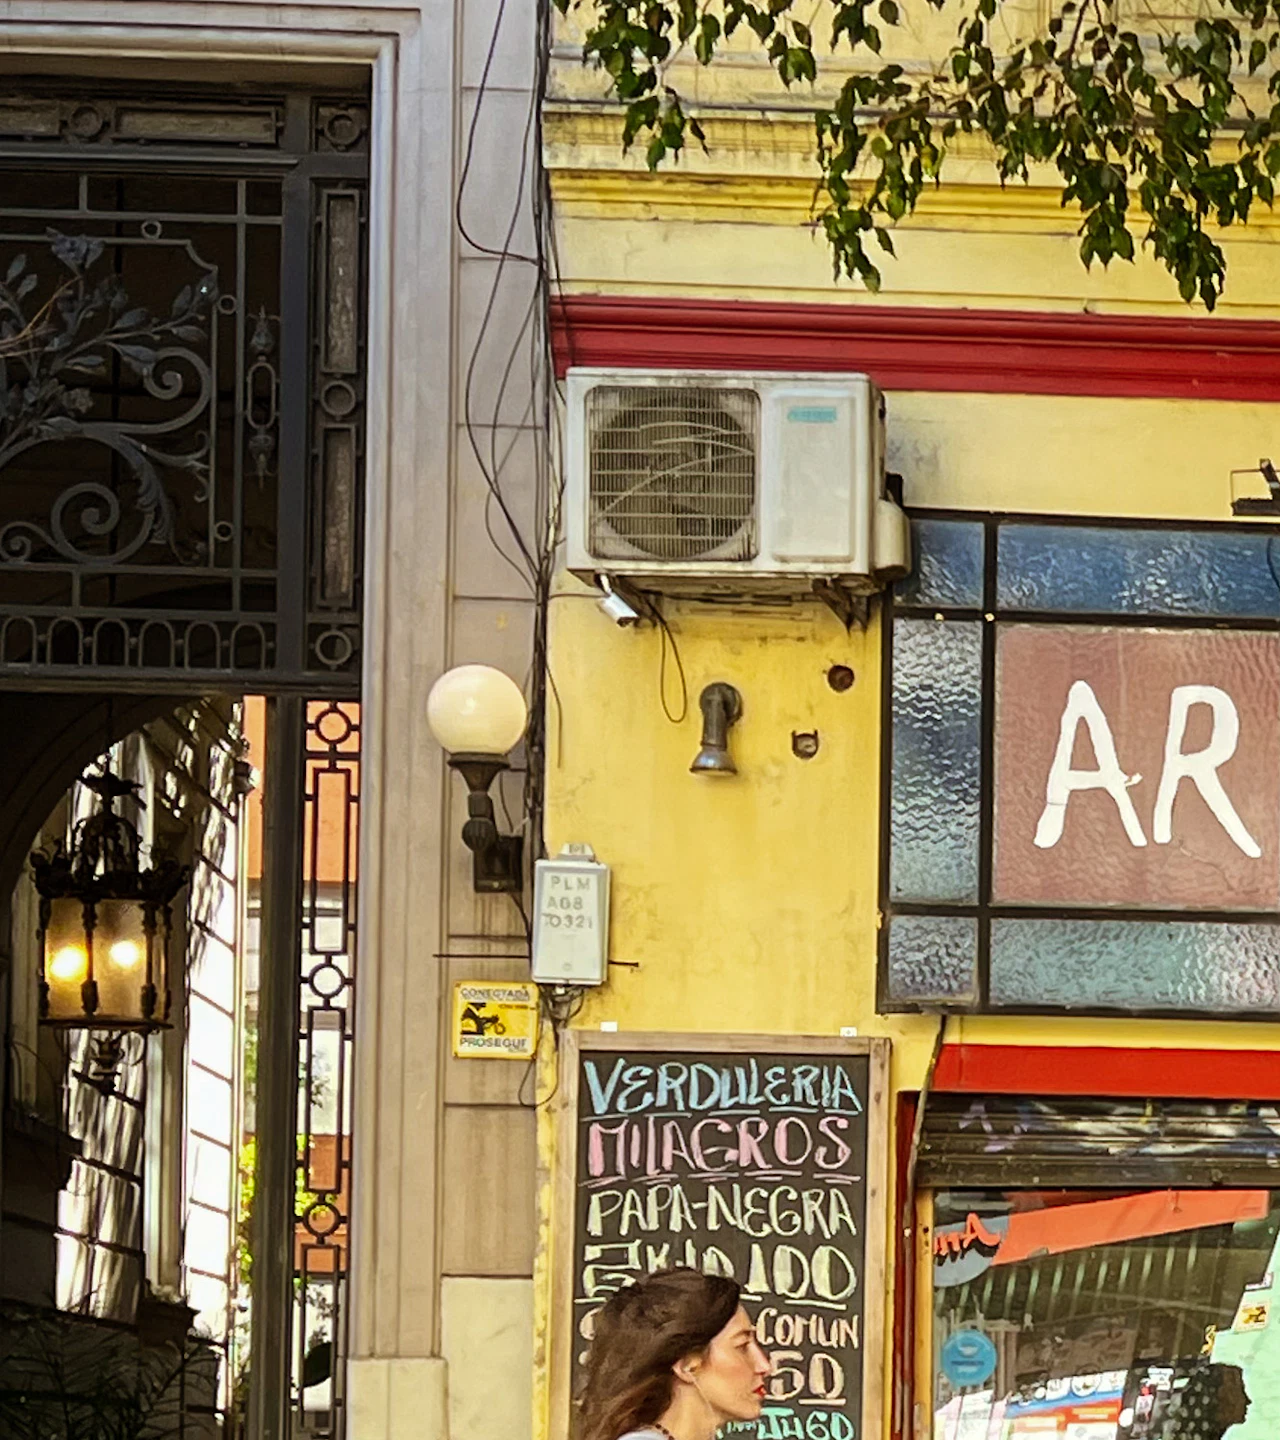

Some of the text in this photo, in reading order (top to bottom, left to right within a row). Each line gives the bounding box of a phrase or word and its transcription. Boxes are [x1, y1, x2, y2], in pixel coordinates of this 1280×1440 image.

[550, 875, 591, 891] PLM
[583, 1058, 863, 1115] VERDULERIA
[587, 1116, 852, 1178] MILAGROS
[586, 1184, 857, 1239] PAPA-NEGRA
